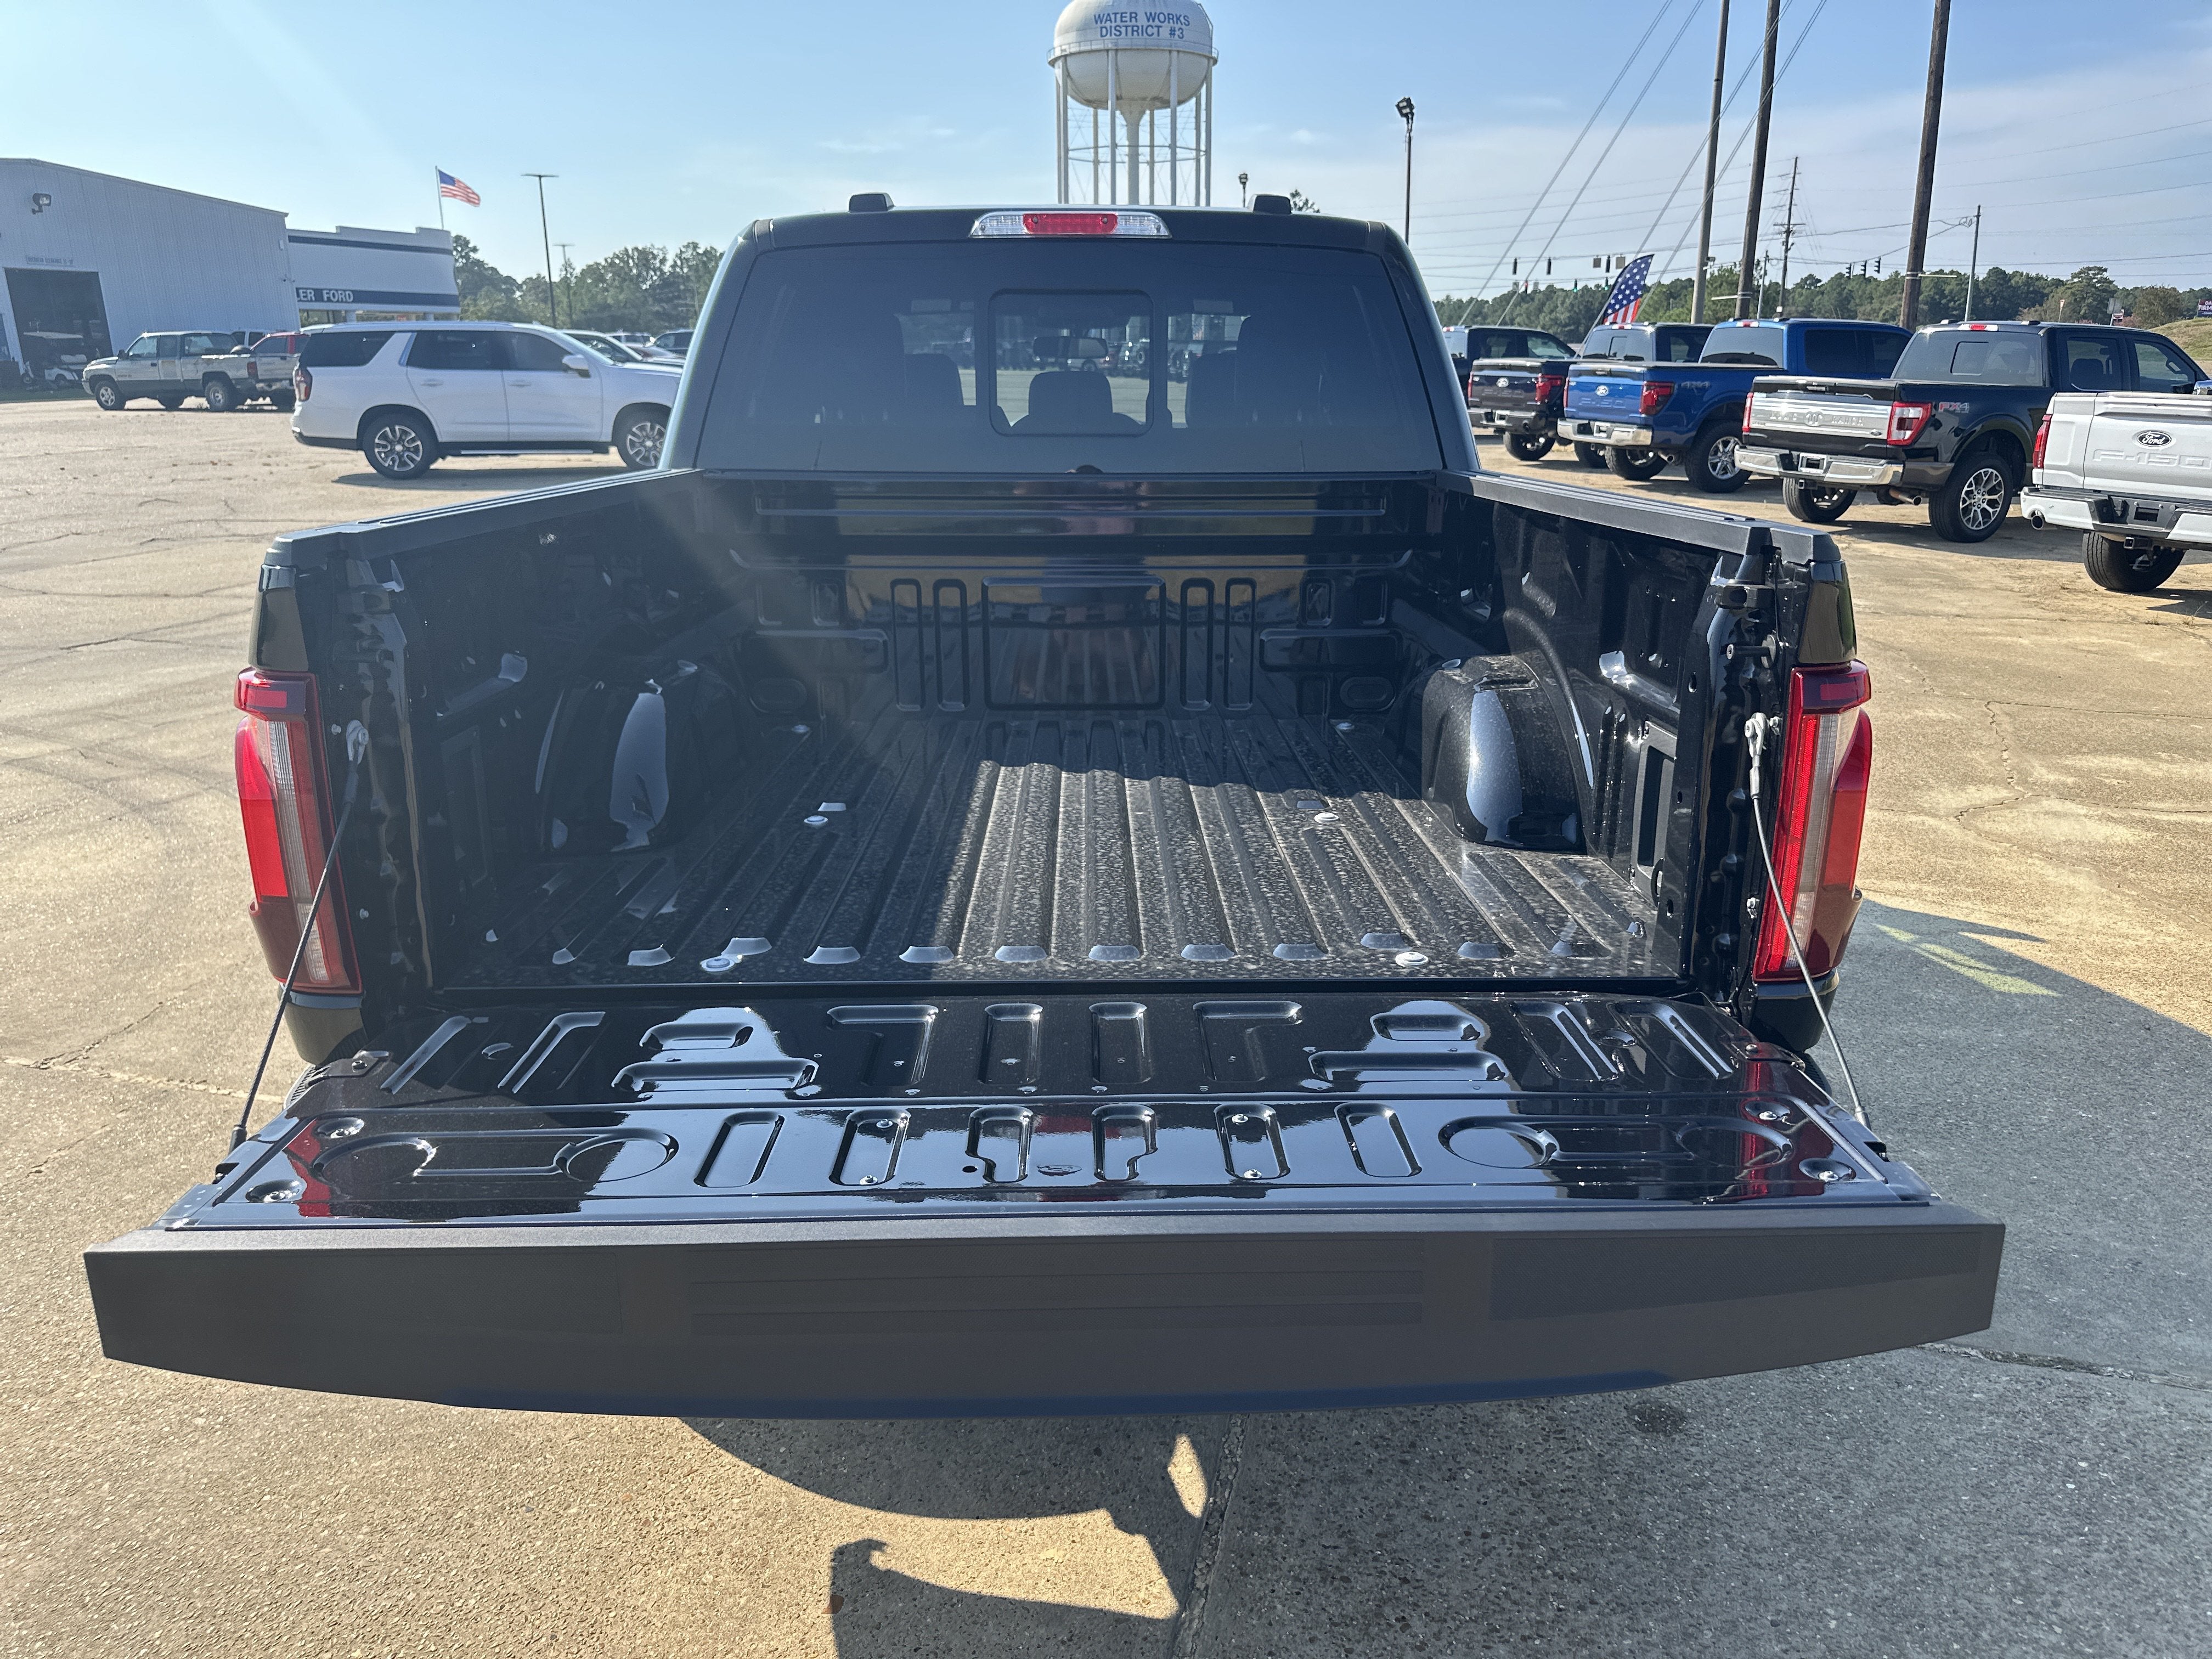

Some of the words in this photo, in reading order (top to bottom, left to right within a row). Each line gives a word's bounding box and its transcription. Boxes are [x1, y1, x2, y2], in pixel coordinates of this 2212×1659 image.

[1093, 12, 1138, 25] WATER
[1144, 12, 1190, 27] WORKS
[1100, 25, 1162, 38] DISTRICT
[1169, 26, 1184, 40] #3
[297, 289, 315, 301] ER
[323, 290, 353, 302] FORD
[1938, 402, 1969, 413] FX4
[2142, 431, 2166, 445] Ford
[2093, 449, 2212, 470] F-150
